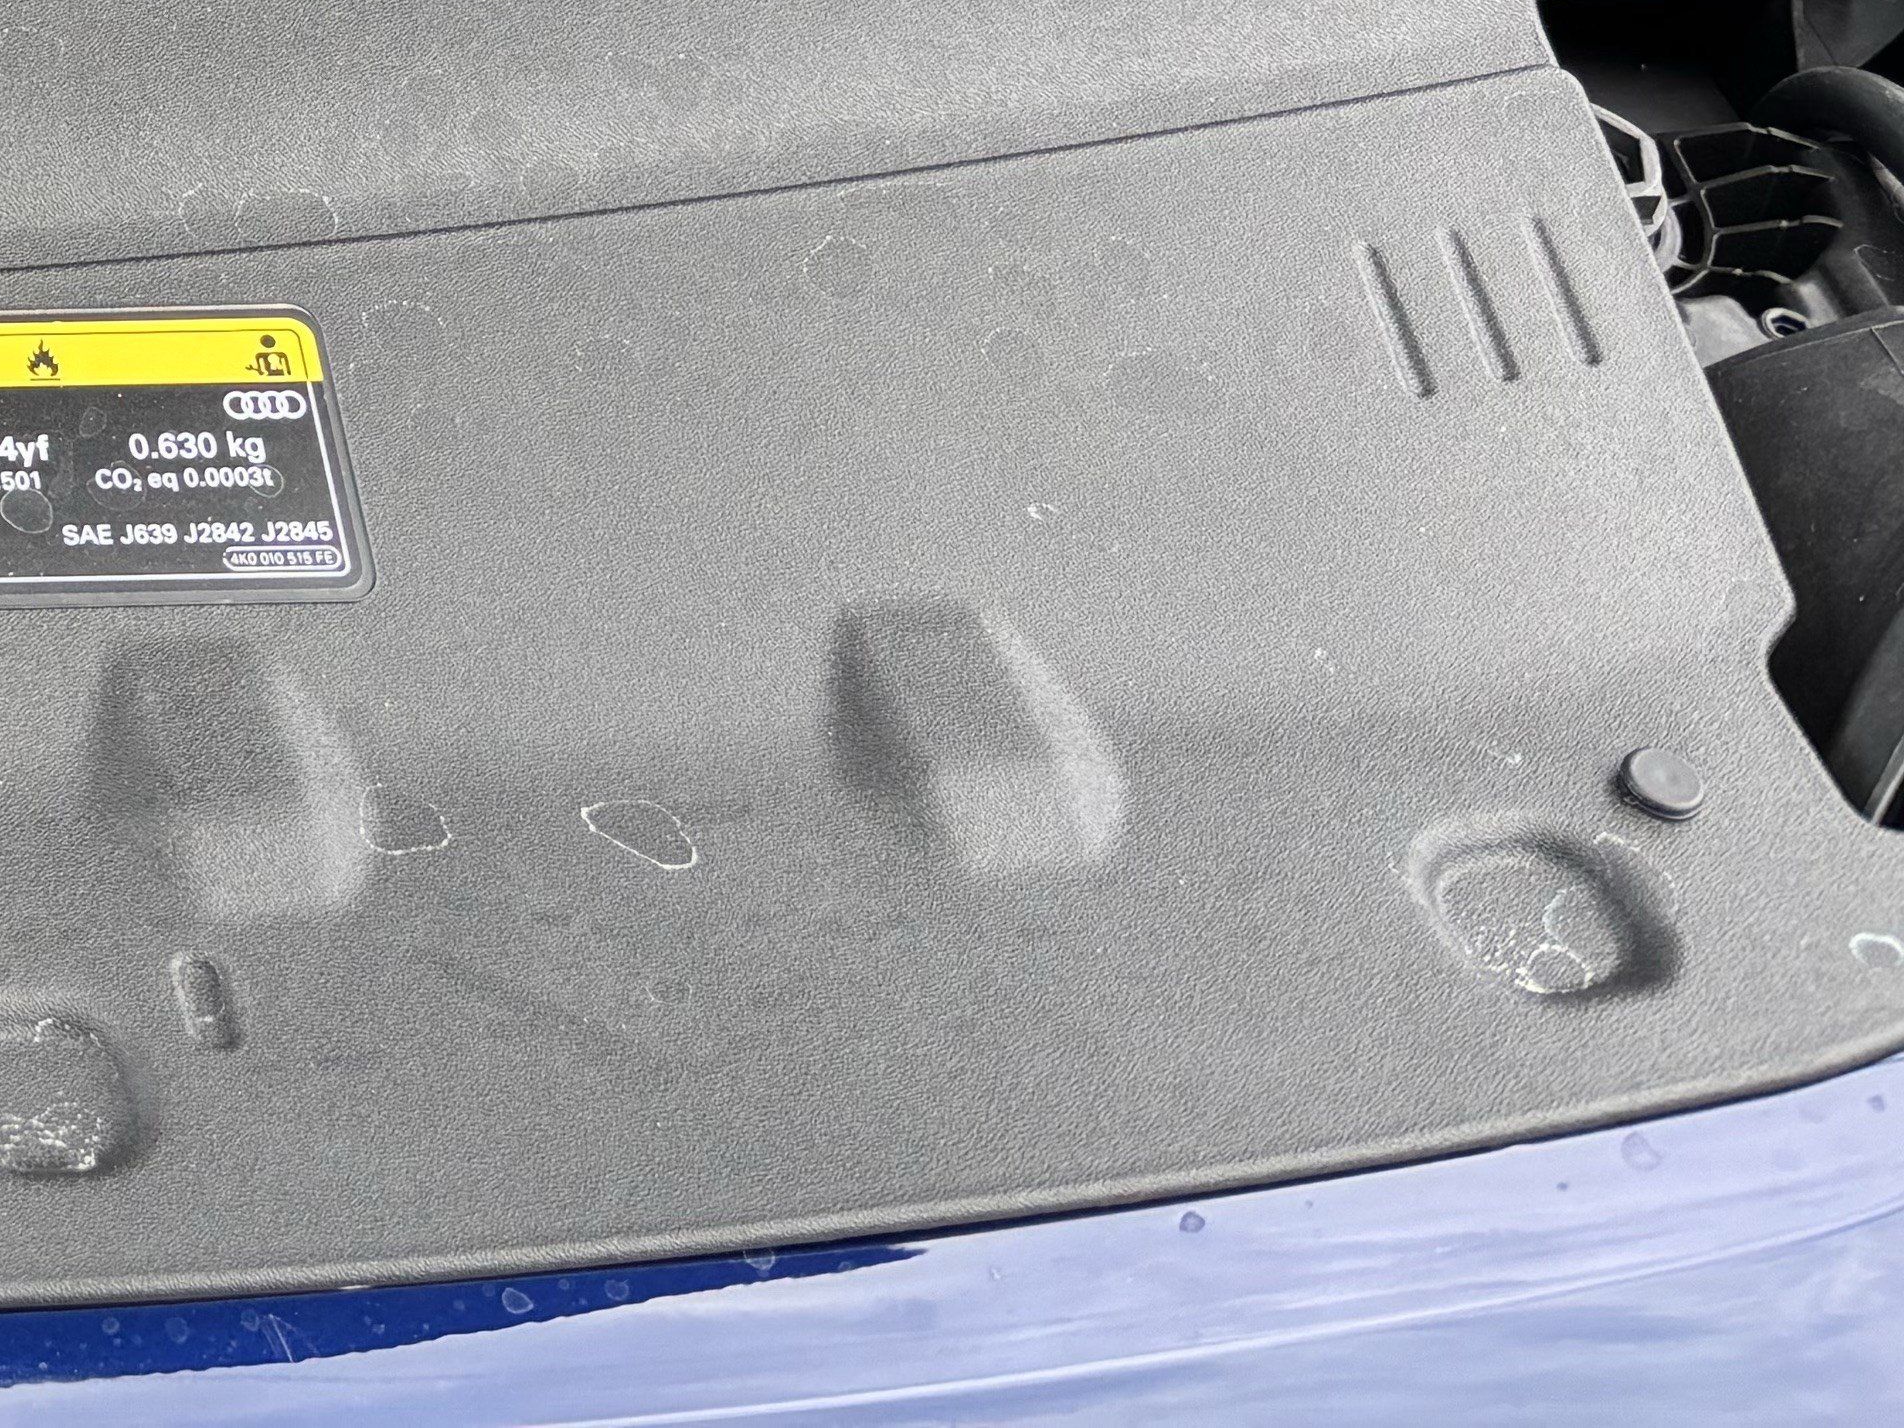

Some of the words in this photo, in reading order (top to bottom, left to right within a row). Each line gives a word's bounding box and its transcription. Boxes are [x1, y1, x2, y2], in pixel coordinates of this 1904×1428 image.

[128, 433, 218, 461] 0.630
[226, 431, 267, 464] kg
[147, 471, 179, 493] eq
[183, 466, 276, 488] 0.0003t
[62, 524, 113, 545] SAE
[120, 524, 178, 545] J639
[184, 522, 254, 544] J2842
[262, 520, 334, 542] J2845
[231, 552, 257, 565] 4K0
[259, 552, 285, 565] 010
[287, 551, 313, 564] 515
[315, 551, 334, 564] FE
